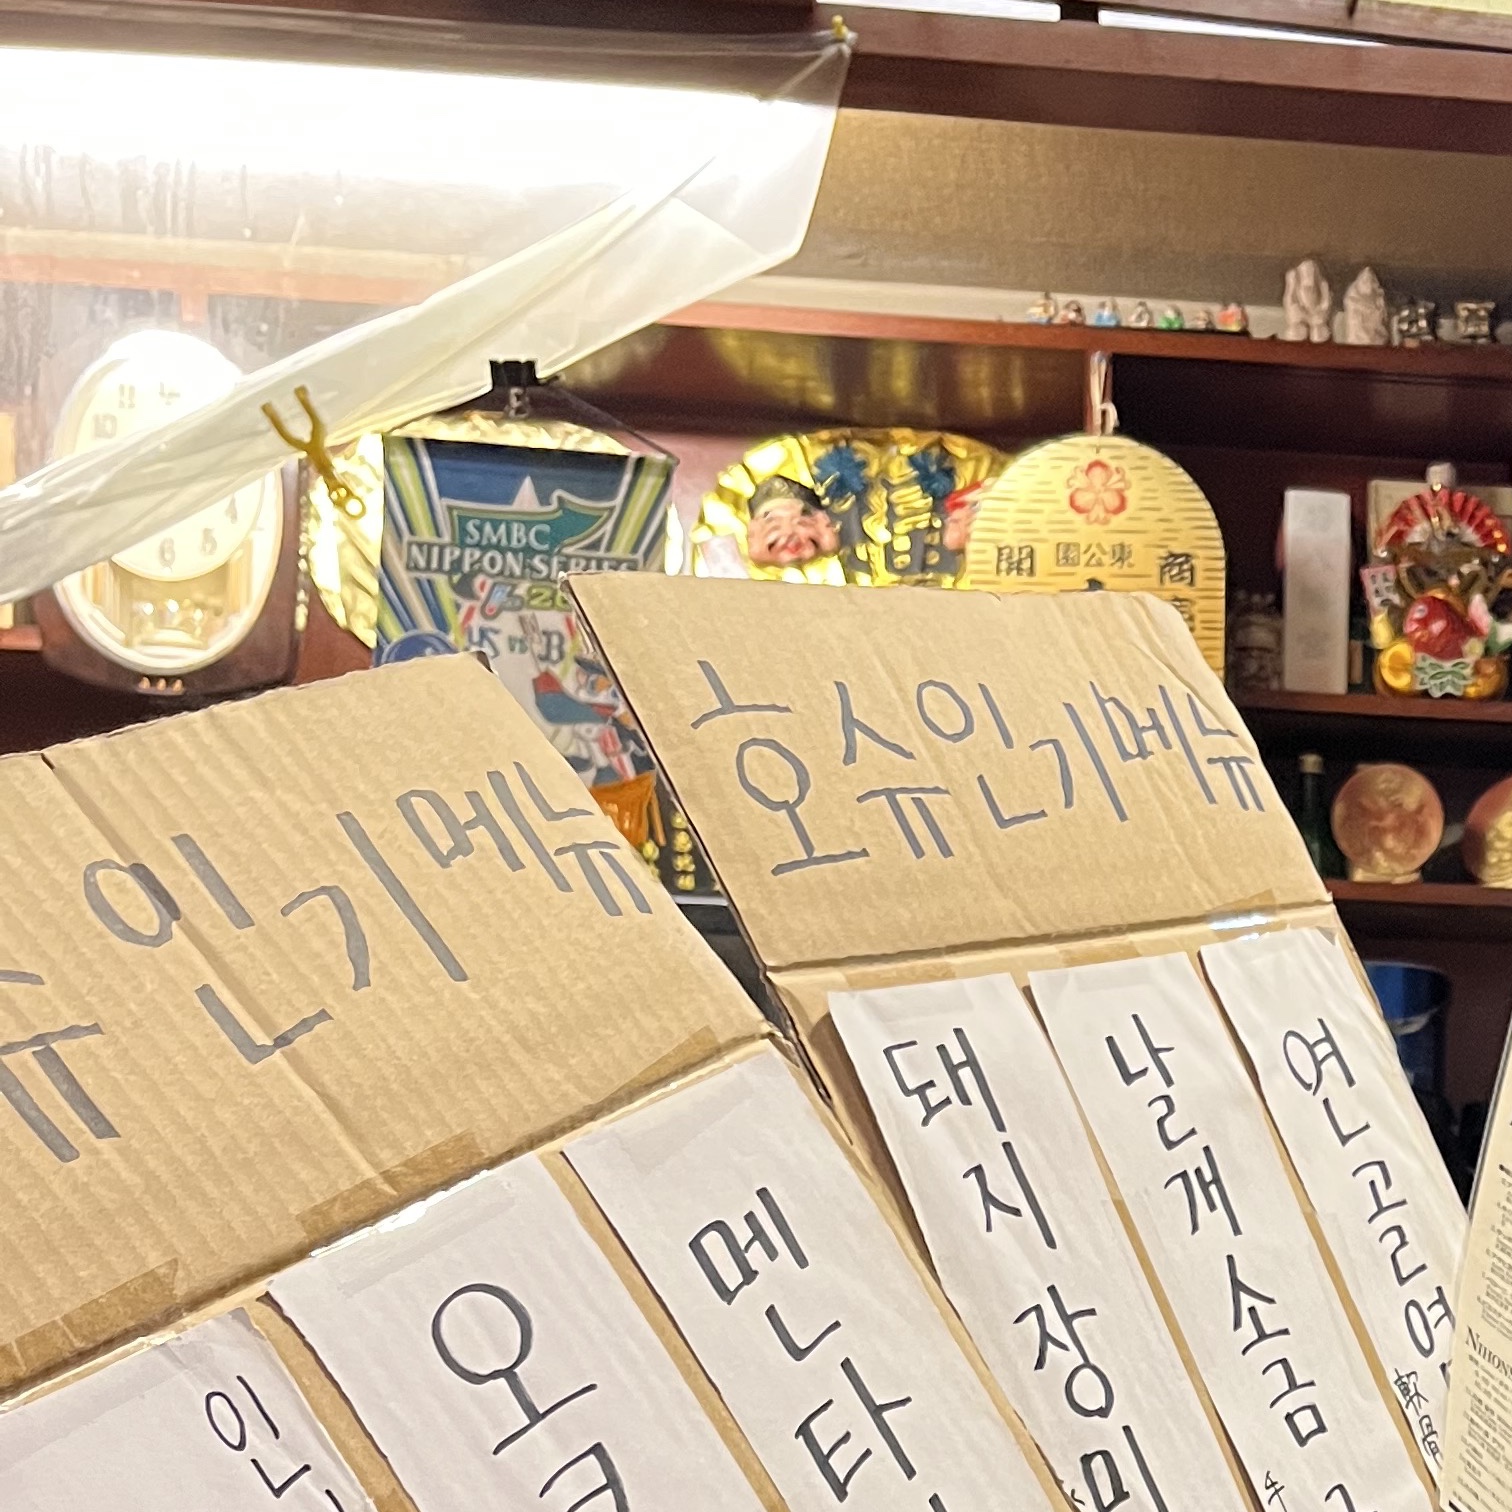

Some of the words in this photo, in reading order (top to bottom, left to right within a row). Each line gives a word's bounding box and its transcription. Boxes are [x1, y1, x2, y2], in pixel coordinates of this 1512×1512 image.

[464, 518, 551, 551] SMBC
[407, 544, 526, 576] NIPPON
[996, 544, 1037, 577] 開
